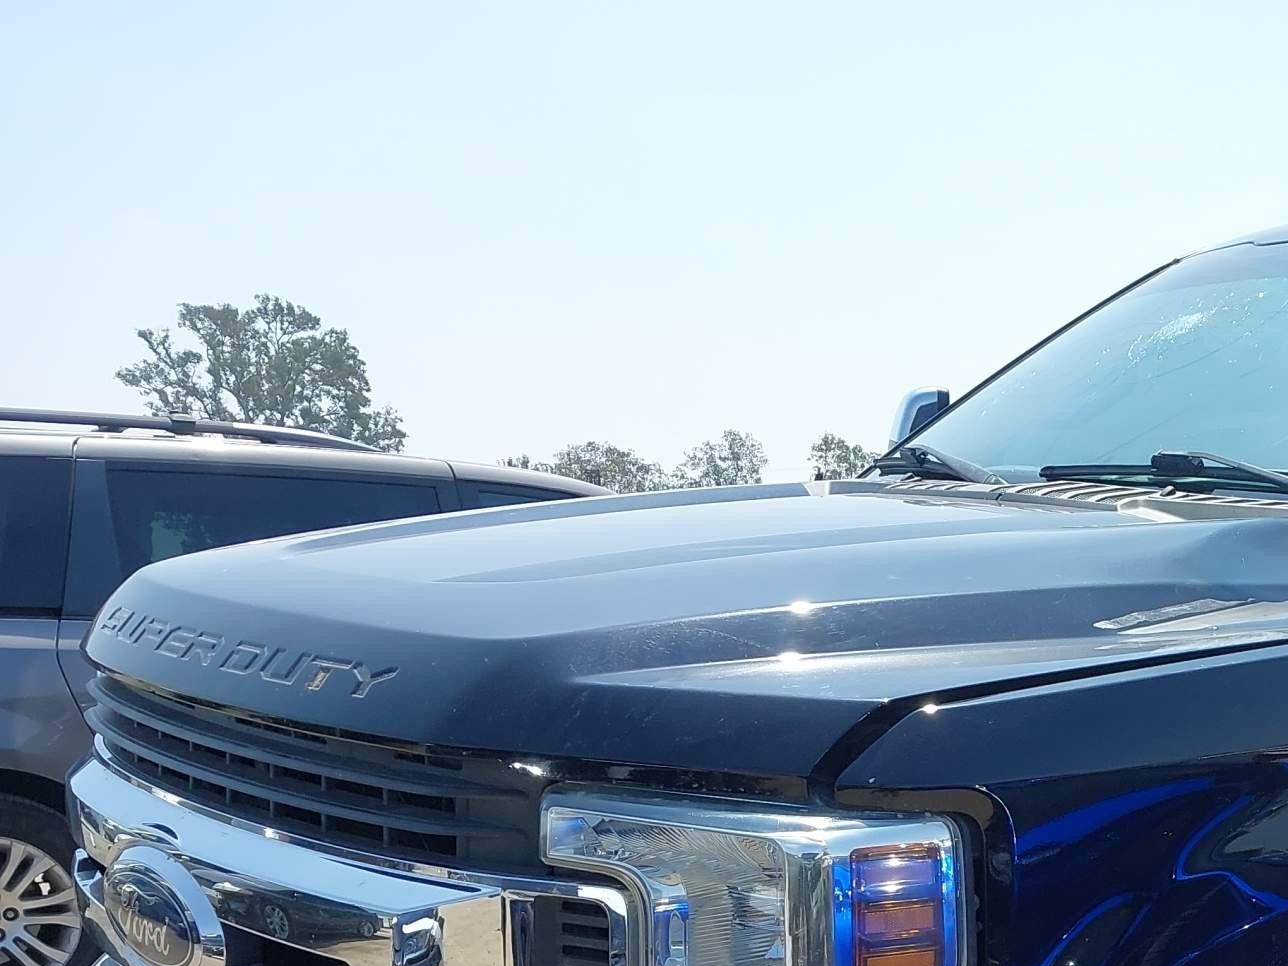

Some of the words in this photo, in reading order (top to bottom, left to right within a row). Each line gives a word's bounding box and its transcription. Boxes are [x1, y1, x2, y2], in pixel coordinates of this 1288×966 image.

[101, 606, 225, 667] SUPER
[219, 640, 400, 698] DUTY
[117, 882, 170, 956] Ford
